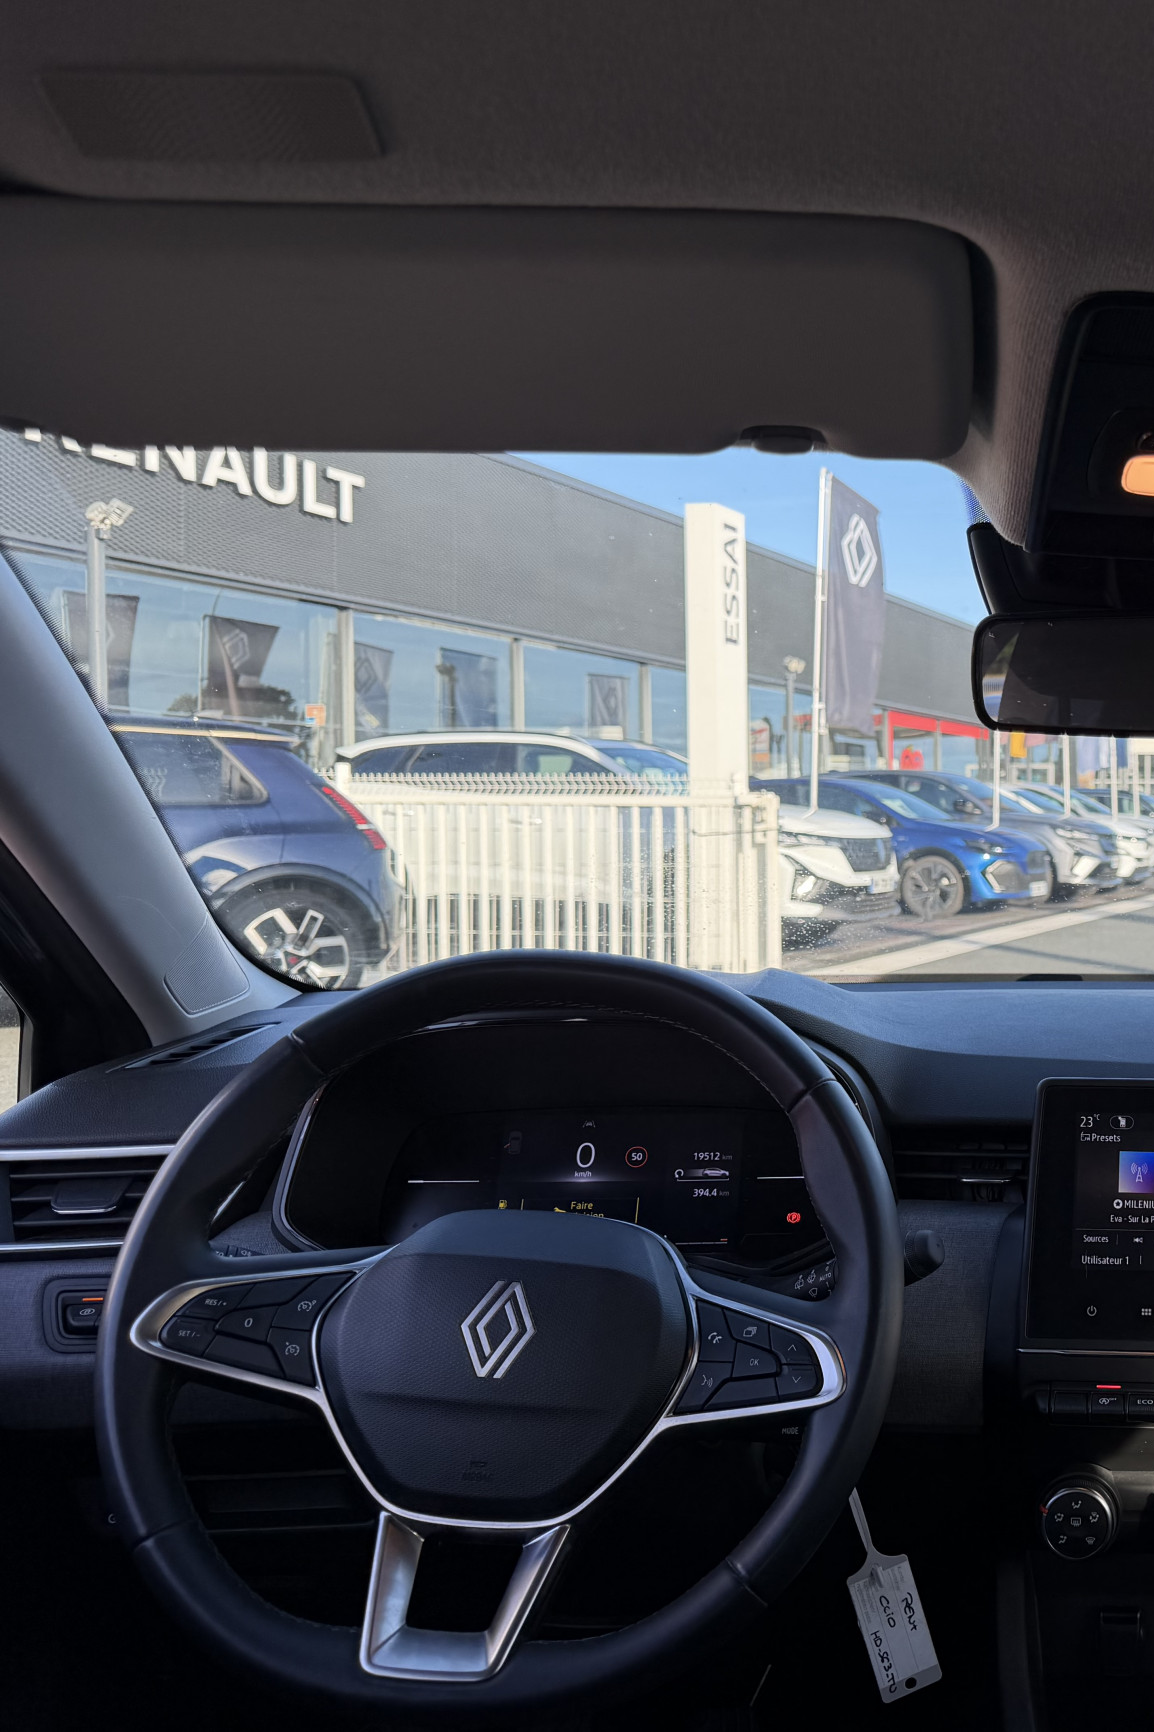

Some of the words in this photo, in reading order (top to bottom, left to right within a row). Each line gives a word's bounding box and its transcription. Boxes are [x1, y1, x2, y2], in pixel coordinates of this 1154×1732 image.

[24, 428, 366, 523] NAULT
[723, 523, 740, 644] ESSAI
[1091, 1132, 1121, 1142] Presets
[576, 1142, 596, 1168] 0
[631, 1152, 643, 1161] 50
[693, 1152, 720, 1161] 19512
[574, 1170, 592, 1178] km/h
[692, 1188, 717, 1197] 394.4
[570, 1201, 593, 1210] Faire
[1110, 1214, 1123, 1223] Eva
[1128, 1215, 1139, 1223] Sur
[1141, 1215, 1149, 1224] La
[1083, 1234, 1109, 1243] Sources
[1081, 1255, 1123, 1265] Utilisateur
[1125, 1256, 1129, 1265] 1
[749, 1358, 760, 1366] OK
